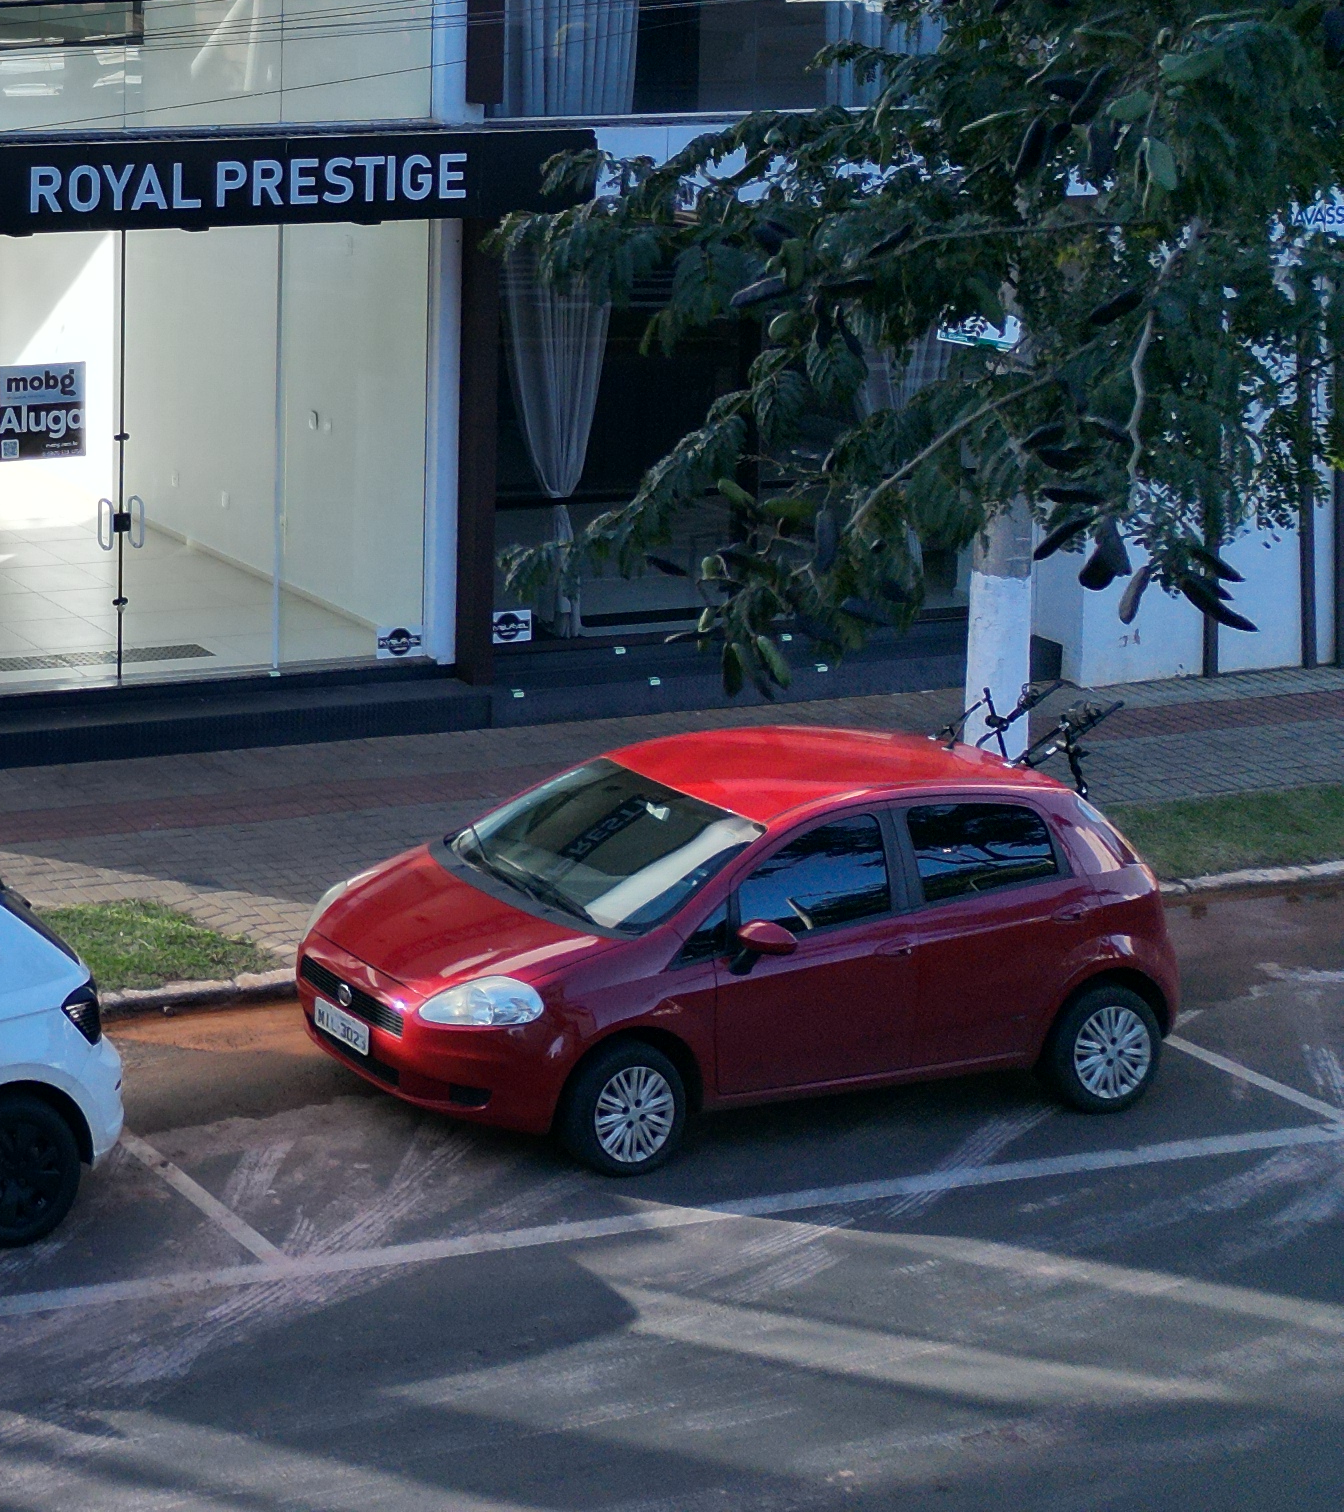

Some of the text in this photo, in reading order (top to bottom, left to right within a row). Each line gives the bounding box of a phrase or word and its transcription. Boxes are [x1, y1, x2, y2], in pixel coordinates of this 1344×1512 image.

[29, 152, 468, 213] ROYAL PRESTIGE
[6, 368, 77, 396] mobg
